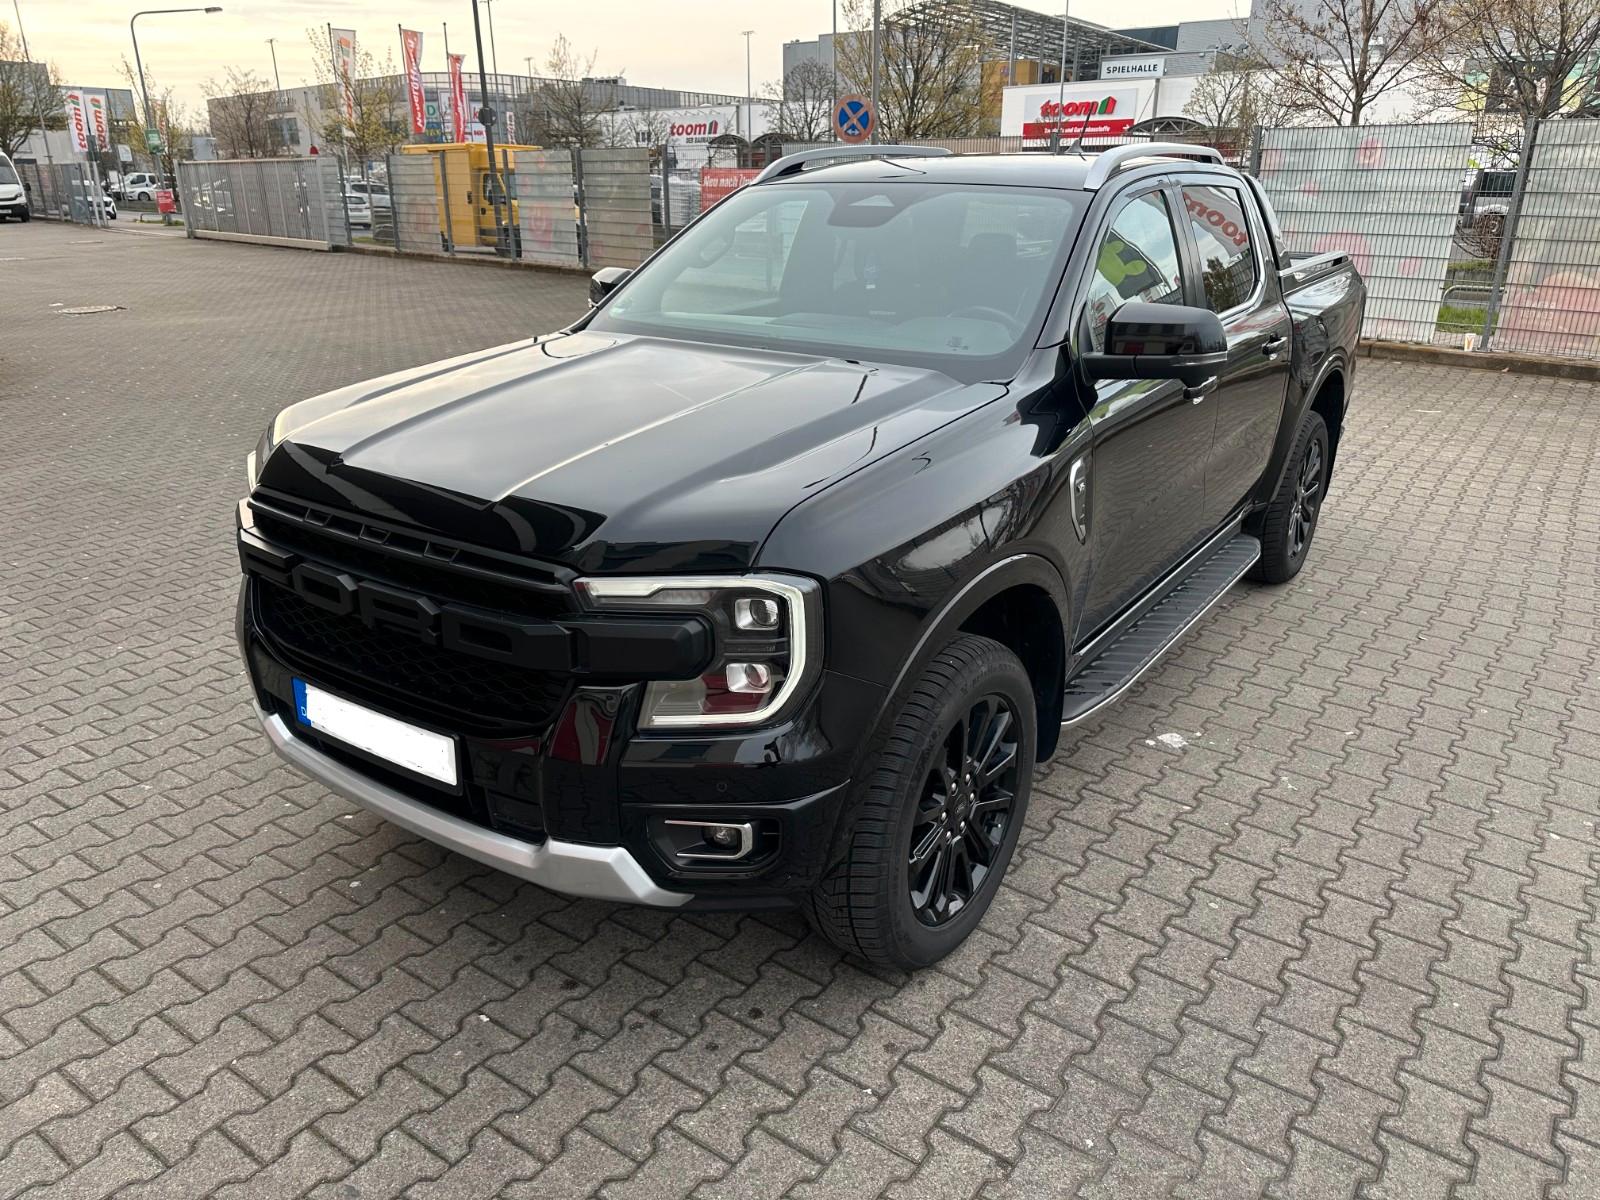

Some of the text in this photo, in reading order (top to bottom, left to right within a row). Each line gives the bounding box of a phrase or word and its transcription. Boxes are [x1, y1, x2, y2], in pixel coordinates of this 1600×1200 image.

[1106, 64, 1158, 74] SPIELHALLE
[1041, 99, 1099, 117] toom
[73, 107, 87, 149] toom
[670, 121, 707, 136] toom
[238, 530, 575, 671] FORD
